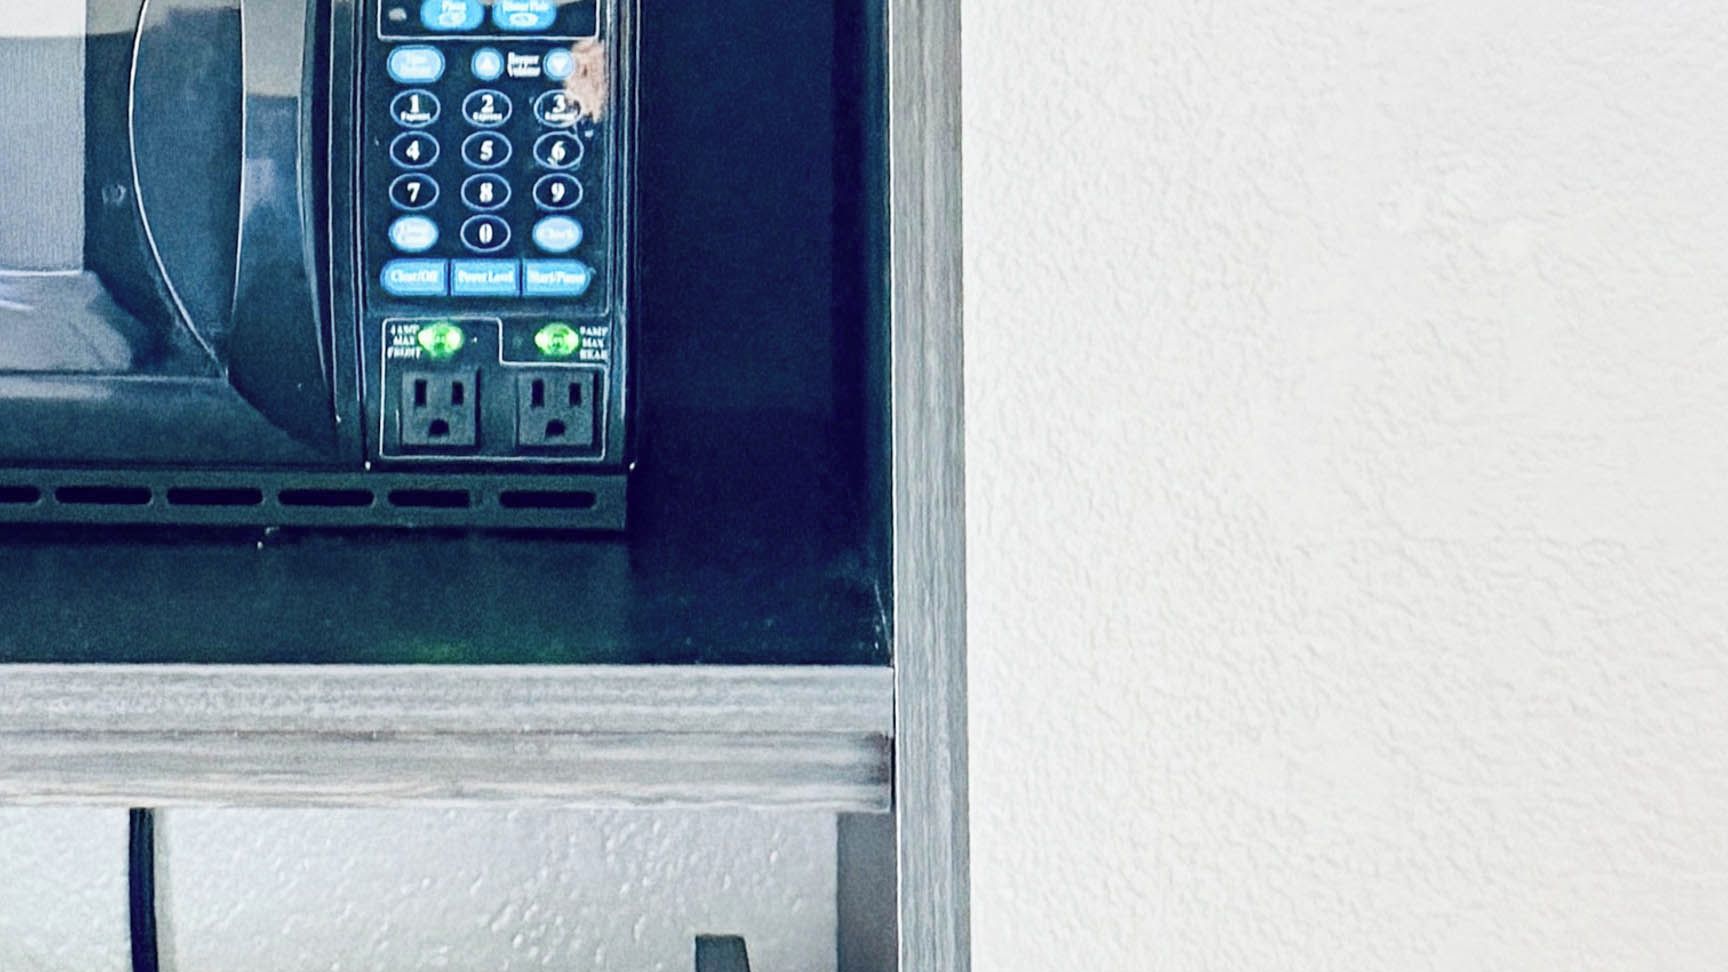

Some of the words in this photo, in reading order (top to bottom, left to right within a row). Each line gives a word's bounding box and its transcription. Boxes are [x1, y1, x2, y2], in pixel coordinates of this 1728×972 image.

[410, 94, 420, 113] 1
[481, 94, 494, 113] 2
[552, 94, 565, 113] 3
[406, 140, 420, 161] 4
[479, 140, 494, 161] 5
[551, 140, 566, 161] 6
[406, 182, 421, 203] 7
[479, 182, 493, 203] 8
[551, 182, 565, 203] 9
[478, 223, 493, 245] 0
